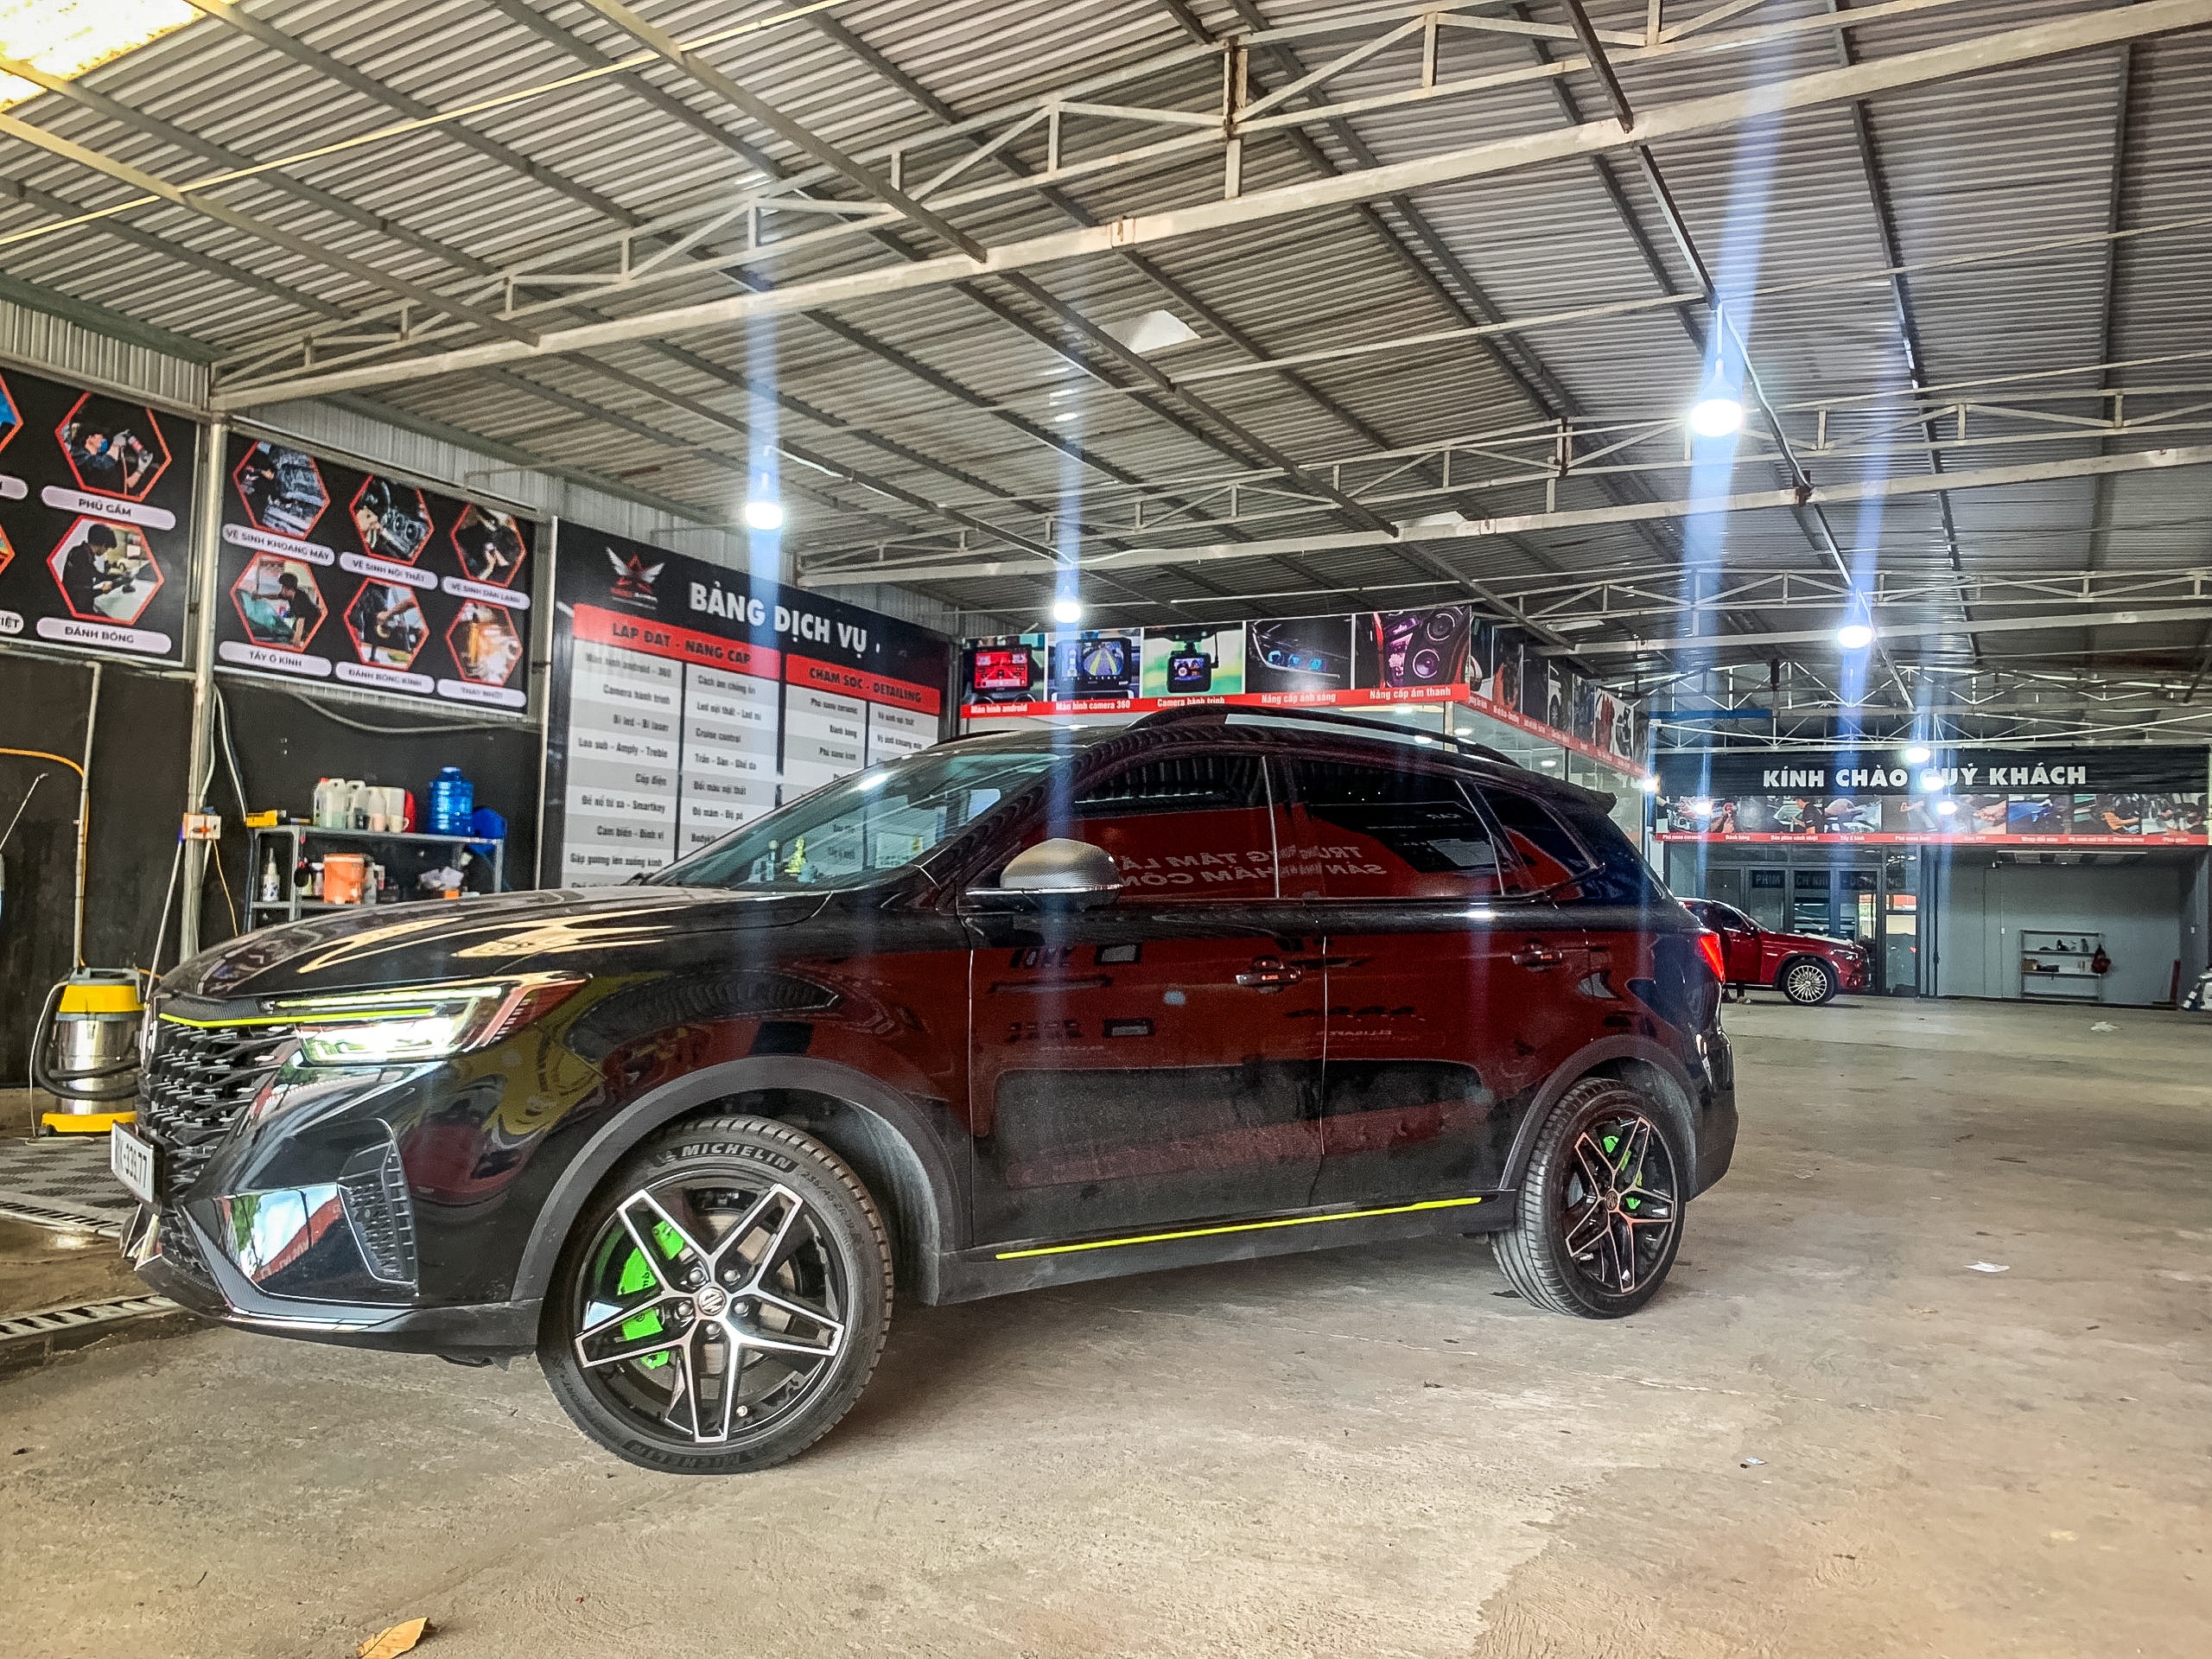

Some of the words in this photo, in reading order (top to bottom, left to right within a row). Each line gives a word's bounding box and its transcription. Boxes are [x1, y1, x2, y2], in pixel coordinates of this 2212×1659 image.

[690, 580, 766, 627] BẢNG
[774, 605, 831, 643] DỊCH
[836, 622, 868, 658] VỤ
[1427, 686, 1452, 697] thanh
[1001, 702, 1028, 714] android
[1089, 700, 1116, 711] camera
[1116, 698, 1131, 710] 360
[1157, 697, 1185, 708] Camera
[1763, 766, 1825, 787] KÍNH
[1835, 764, 1909, 787] CHÀO
[1990, 762, 2087, 786] KHÁCH
[682, 1141, 795, 1170] MICHELIN
